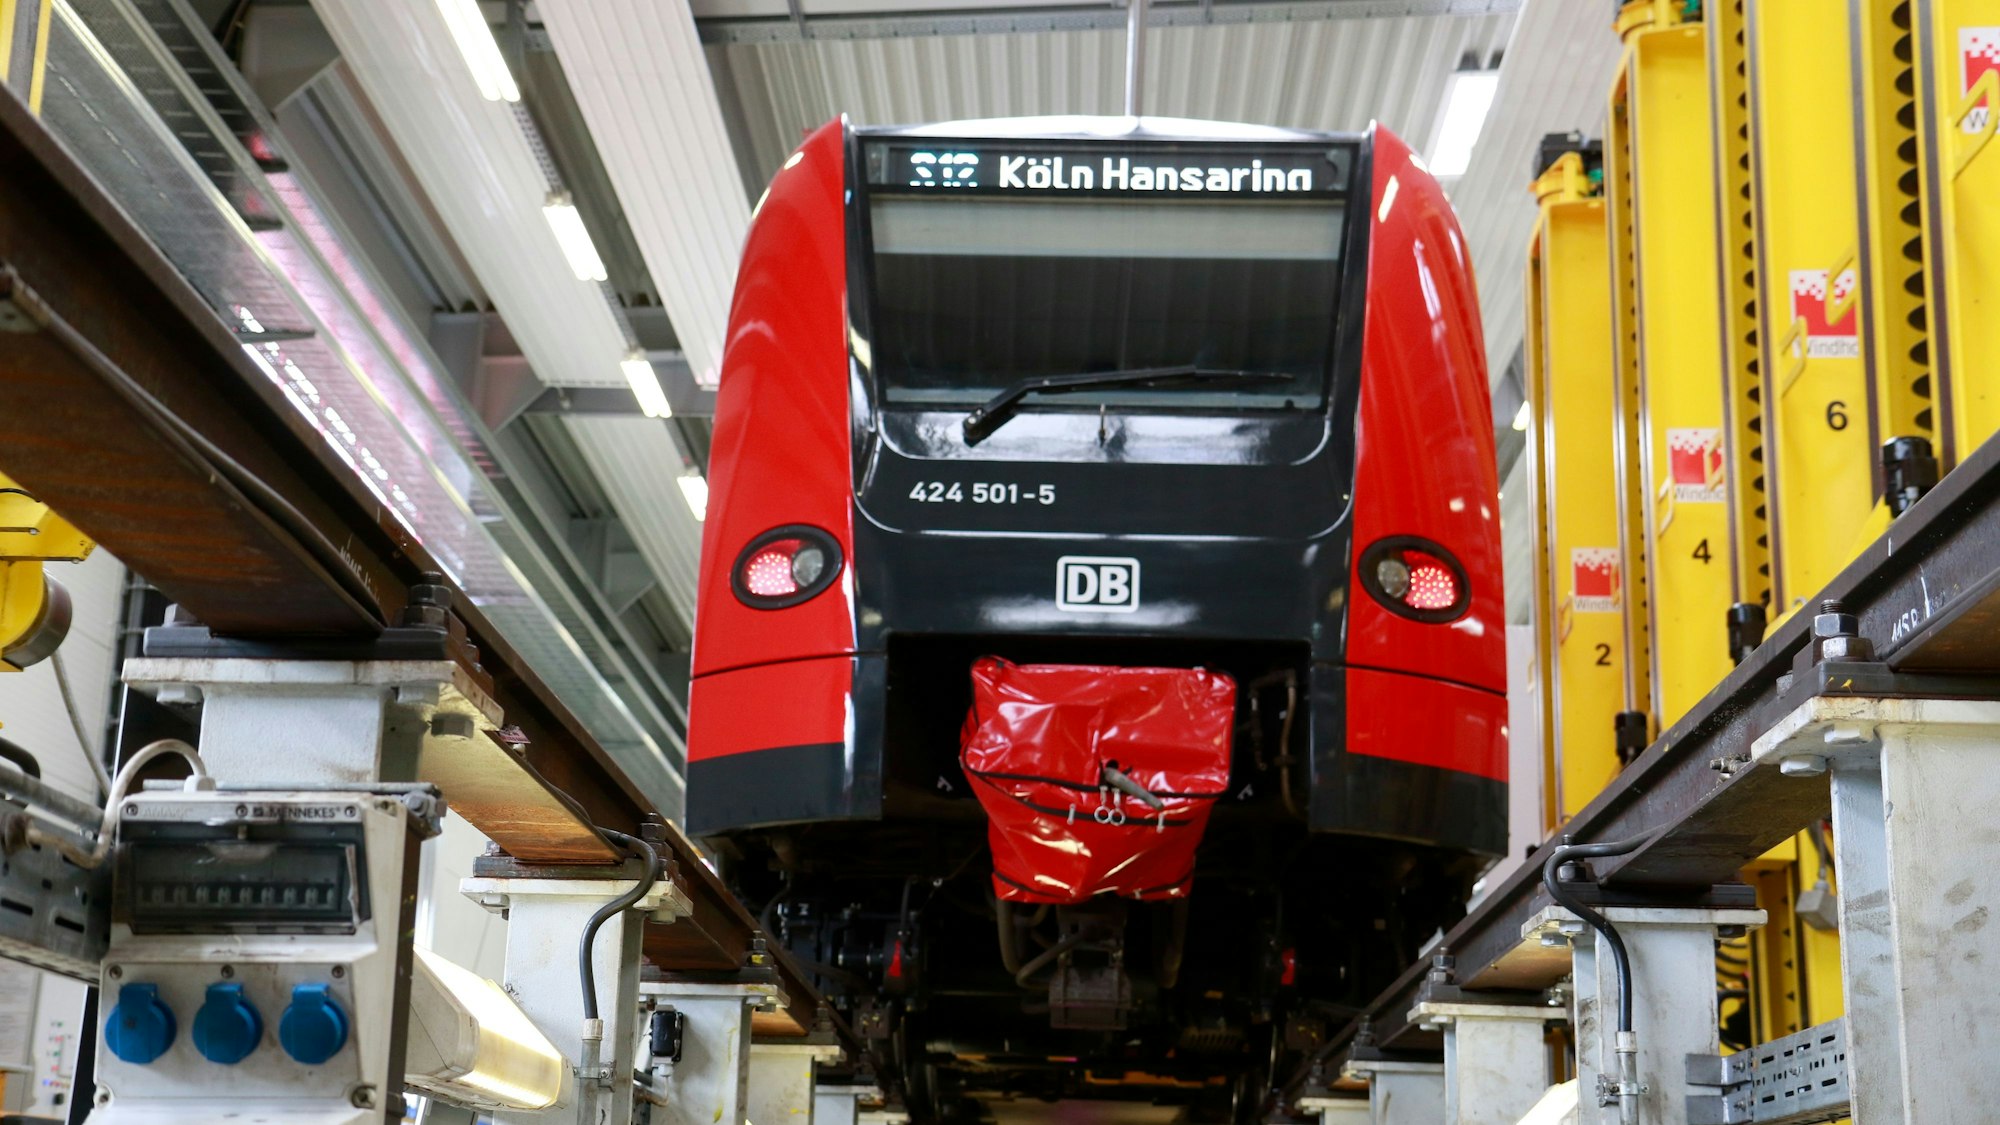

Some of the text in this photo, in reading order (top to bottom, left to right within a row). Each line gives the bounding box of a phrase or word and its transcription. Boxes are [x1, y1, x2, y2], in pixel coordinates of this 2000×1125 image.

[1000, 155, 1094, 190] Köln
[1826, 401, 1848, 431] 6
[909, 481, 1055, 504] 424 501-5
[1692, 538, 1712, 564] 4
[1066, 564, 1130, 605] DB
[1595, 643, 1611, 667] 2
